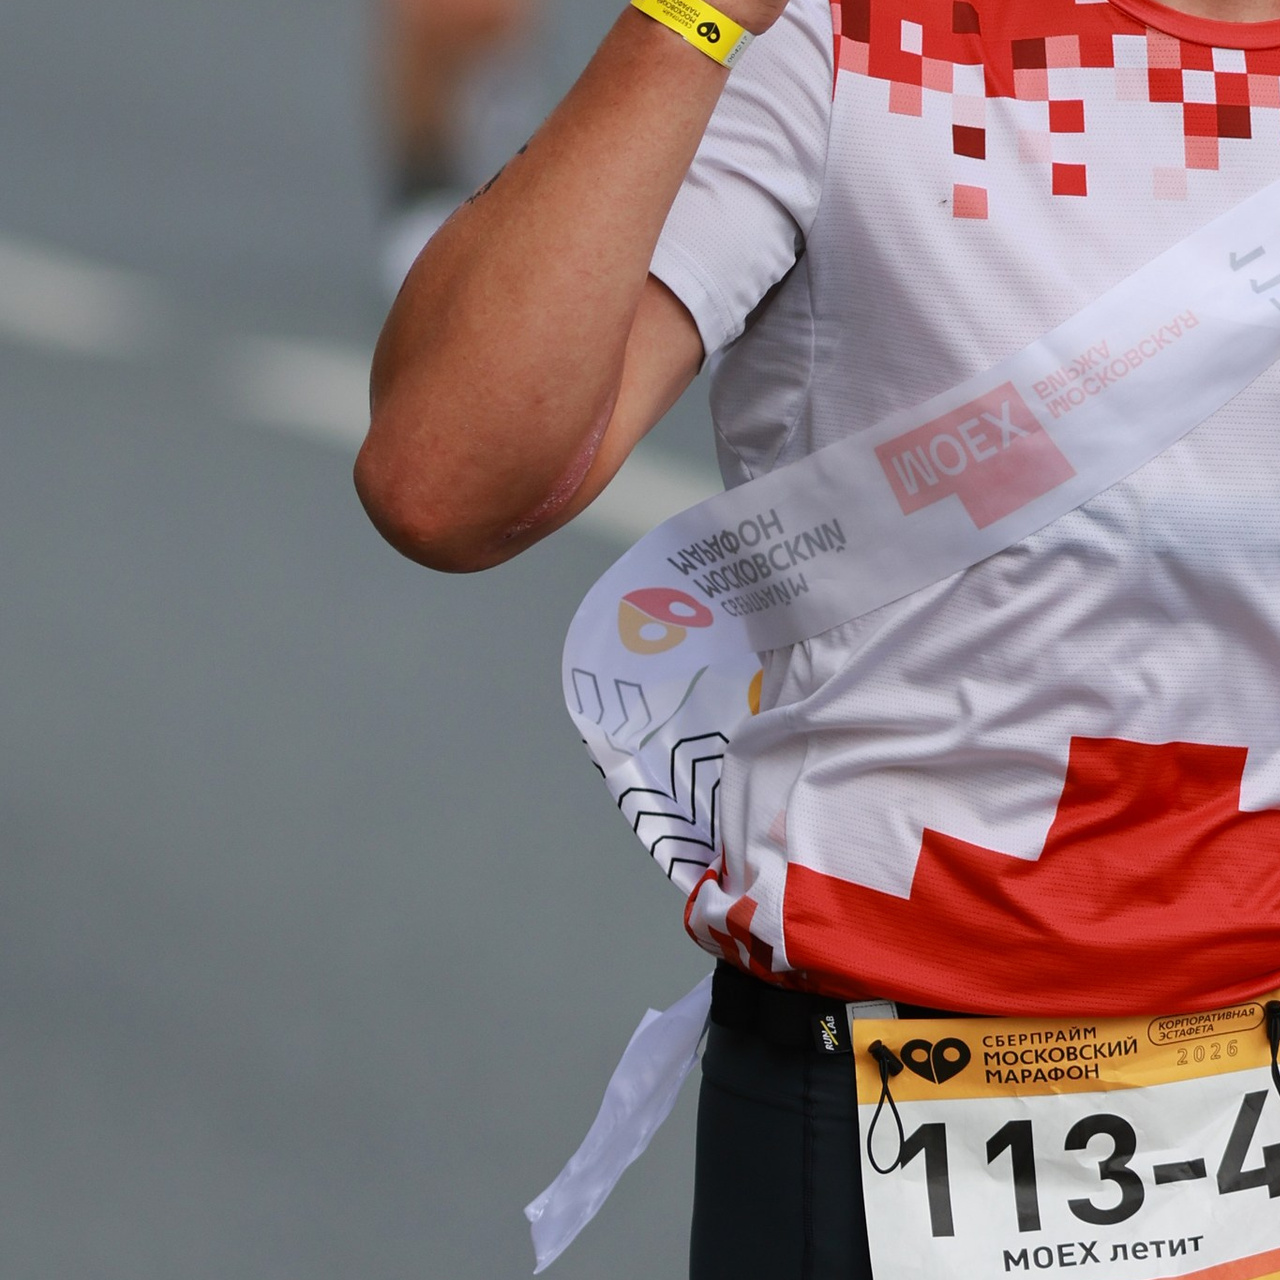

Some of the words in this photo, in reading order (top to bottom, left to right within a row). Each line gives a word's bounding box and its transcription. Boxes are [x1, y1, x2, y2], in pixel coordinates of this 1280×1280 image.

[1158, 1007, 1256, 1031] КОРПОРАТИВНАЯ
[982, 1026, 1097, 1048] СБЕРПРАЙМ
[1158, 1024, 1214, 1041] ЭСТАФЕТА
[983, 1038, 1138, 1066] МОСКОВСКИЙ
[1177, 1039, 1239, 1066] 2026
[985, 1063, 1100, 1084] МАРАФОН
[1110, 1235, 1204, 1264] летит
